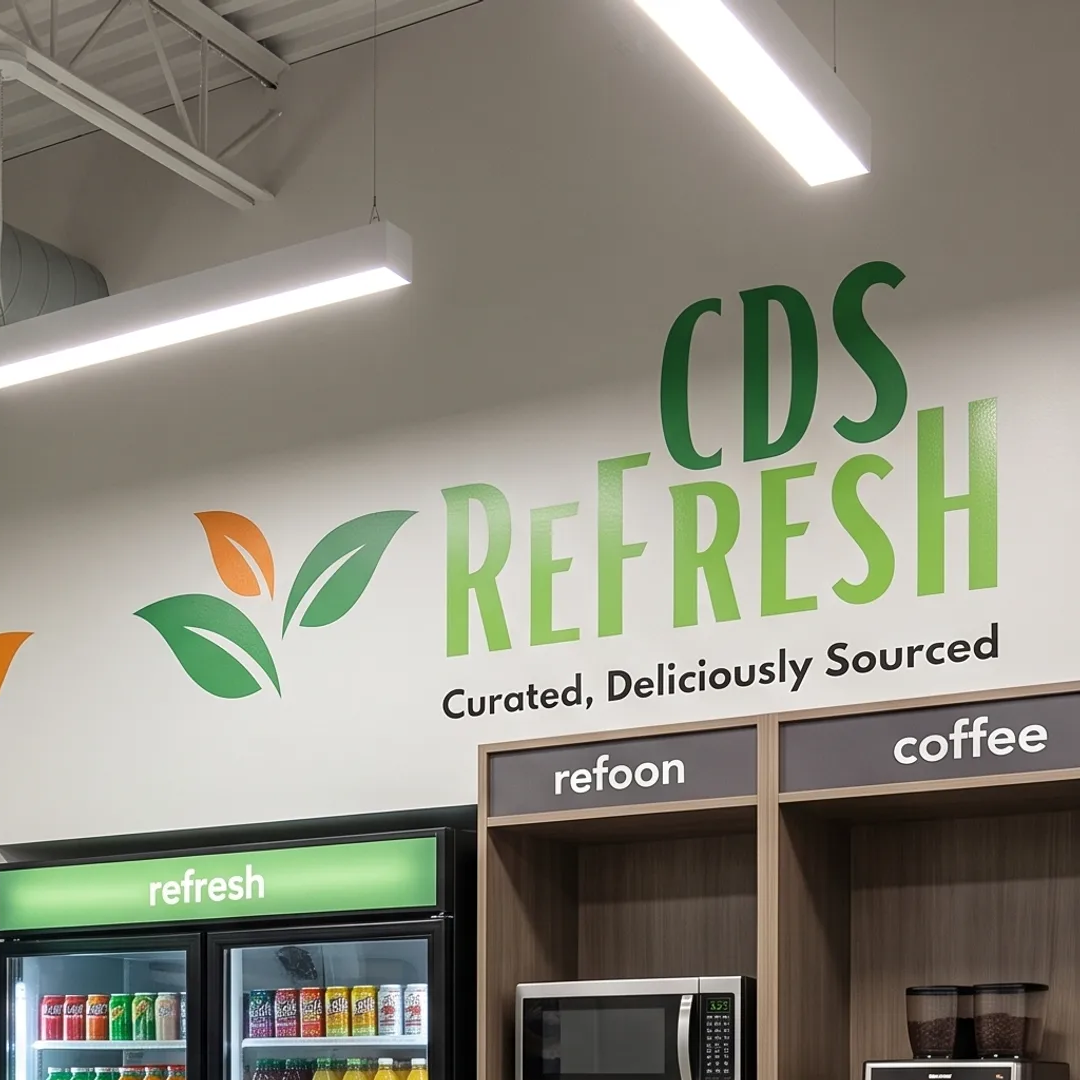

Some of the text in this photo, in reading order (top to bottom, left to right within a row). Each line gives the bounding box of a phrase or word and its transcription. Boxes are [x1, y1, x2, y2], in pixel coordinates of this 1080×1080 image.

[660, 260, 907, 471] CDS
[442, 622, 999, 720] Curated, Deliciously Sourced
[893, 716, 1048, 765] coffee
[554, 754, 685, 795] refoon
[149, 863, 265, 906] refresh
